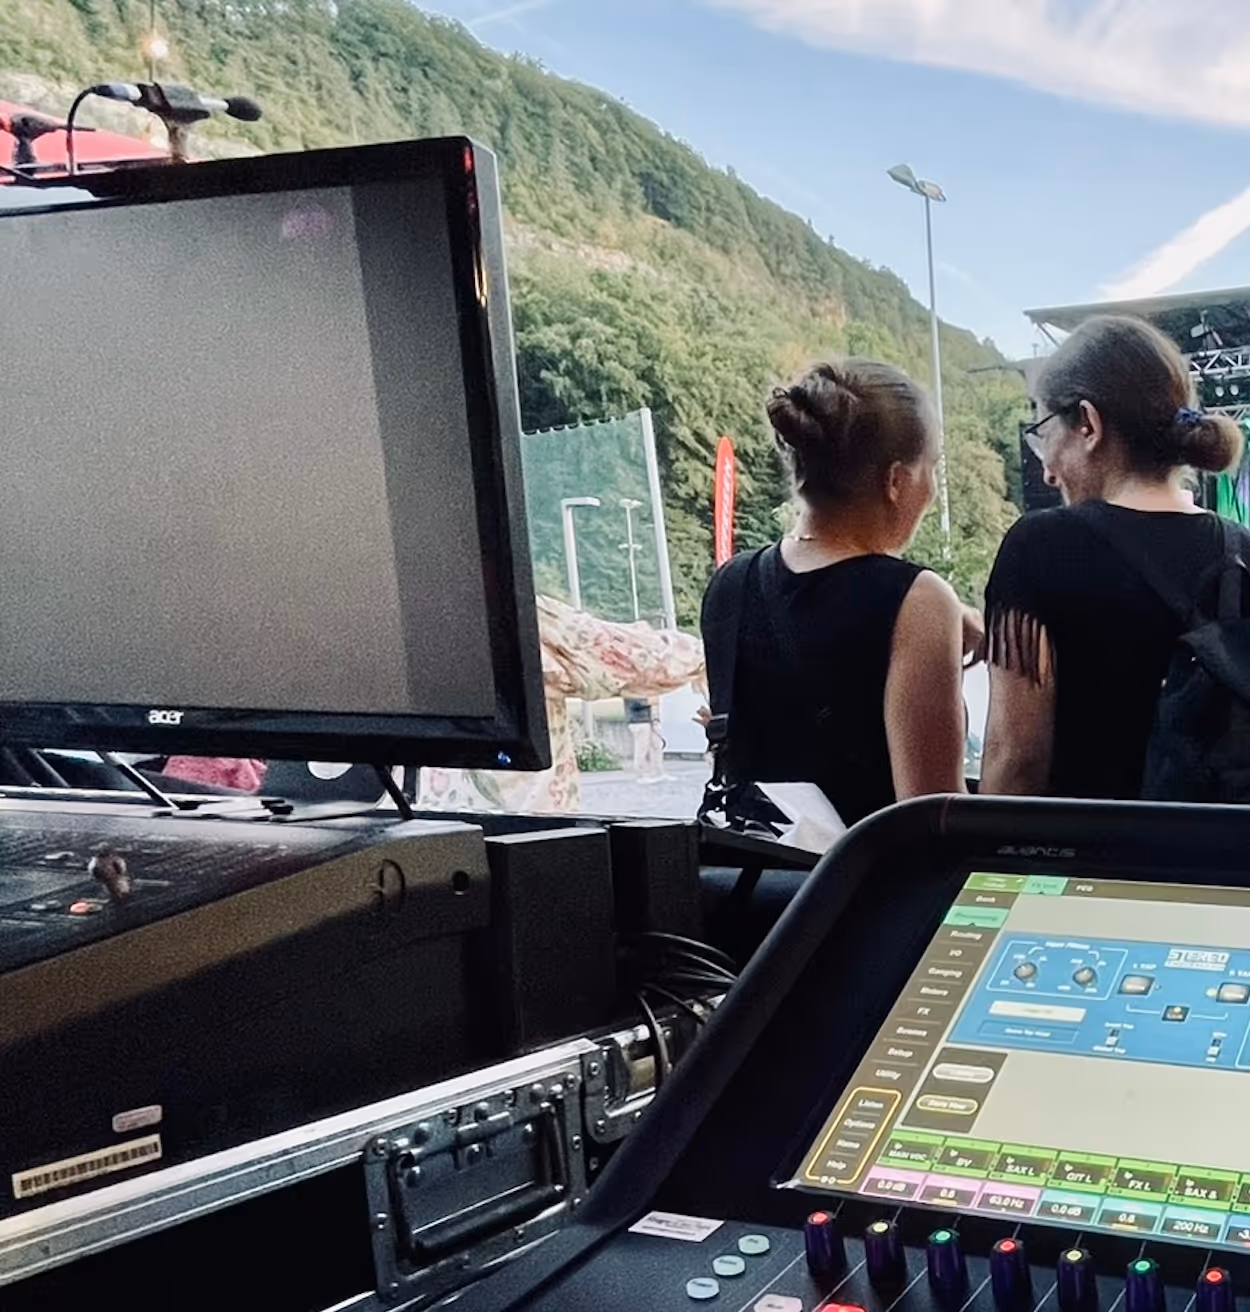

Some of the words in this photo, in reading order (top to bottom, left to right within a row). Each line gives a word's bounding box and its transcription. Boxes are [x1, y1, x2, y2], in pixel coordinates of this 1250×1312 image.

[148, 709, 185, 725] acer
[1127, 1179, 1142, 1190] FX
[1173, 1220, 1193, 1232] 200
[1194, 1223, 1209, 1234] Hz
